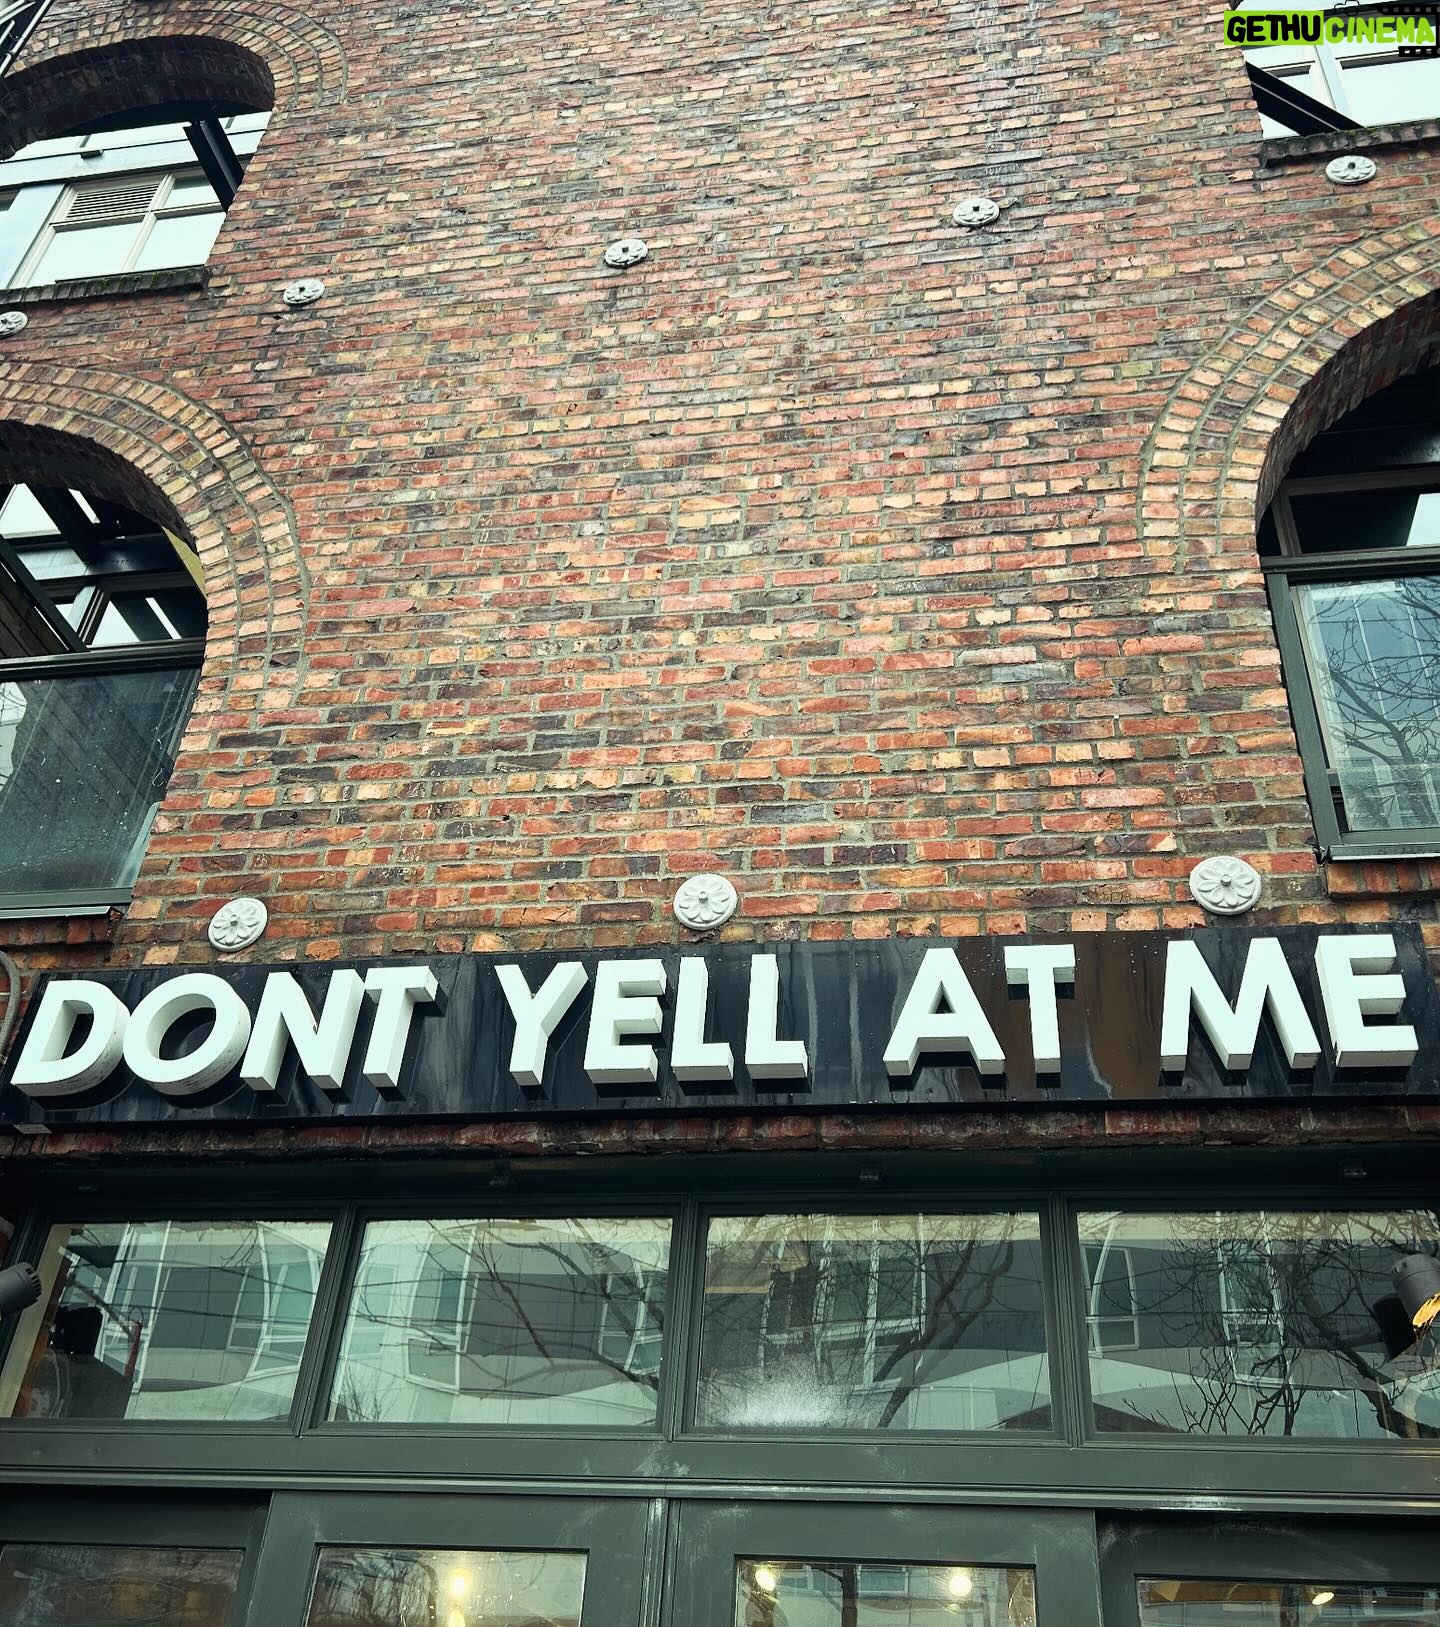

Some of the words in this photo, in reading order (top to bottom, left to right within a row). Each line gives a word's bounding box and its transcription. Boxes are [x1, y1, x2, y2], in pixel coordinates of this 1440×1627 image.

[11, 965, 438, 1096] DONT
[494, 952, 808, 1086] YELL
[882, 943, 1076, 1077] AT
[1160, 933, 1419, 1071] ME
